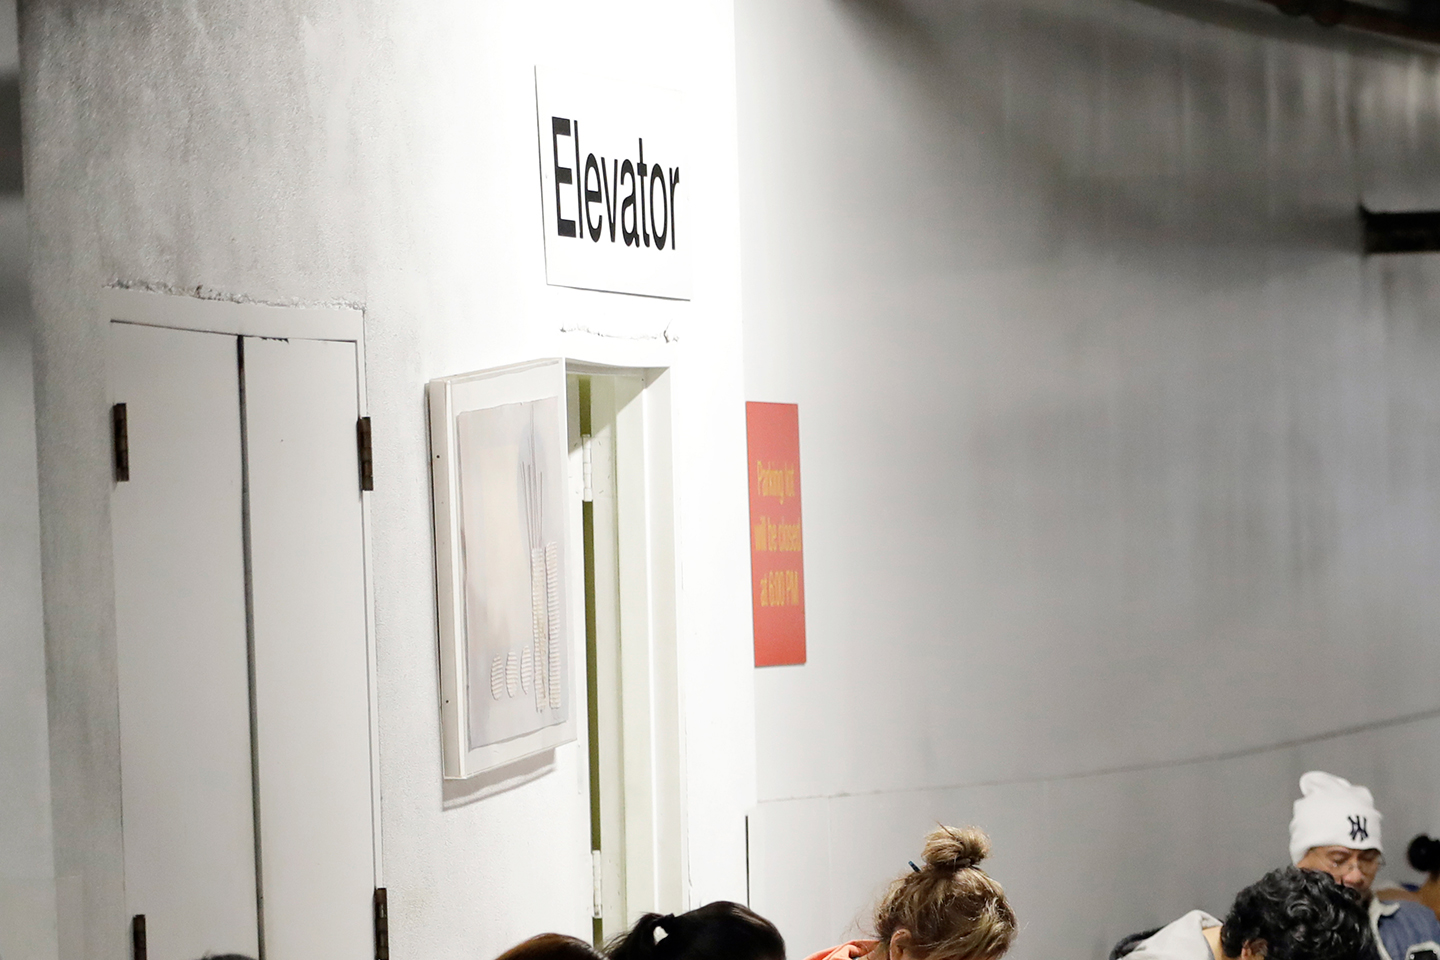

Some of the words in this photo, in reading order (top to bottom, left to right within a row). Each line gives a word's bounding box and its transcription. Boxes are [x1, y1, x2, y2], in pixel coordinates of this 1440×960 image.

[551, 116, 680, 251] Elevator
[757, 460, 784, 505] Parking
[767, 516, 777, 552] be
[778, 515, 802, 552] closed
[760, 573, 768, 607] at
[785, 570, 800, 605] PM
[1347, 814, 1369, 842] NY
